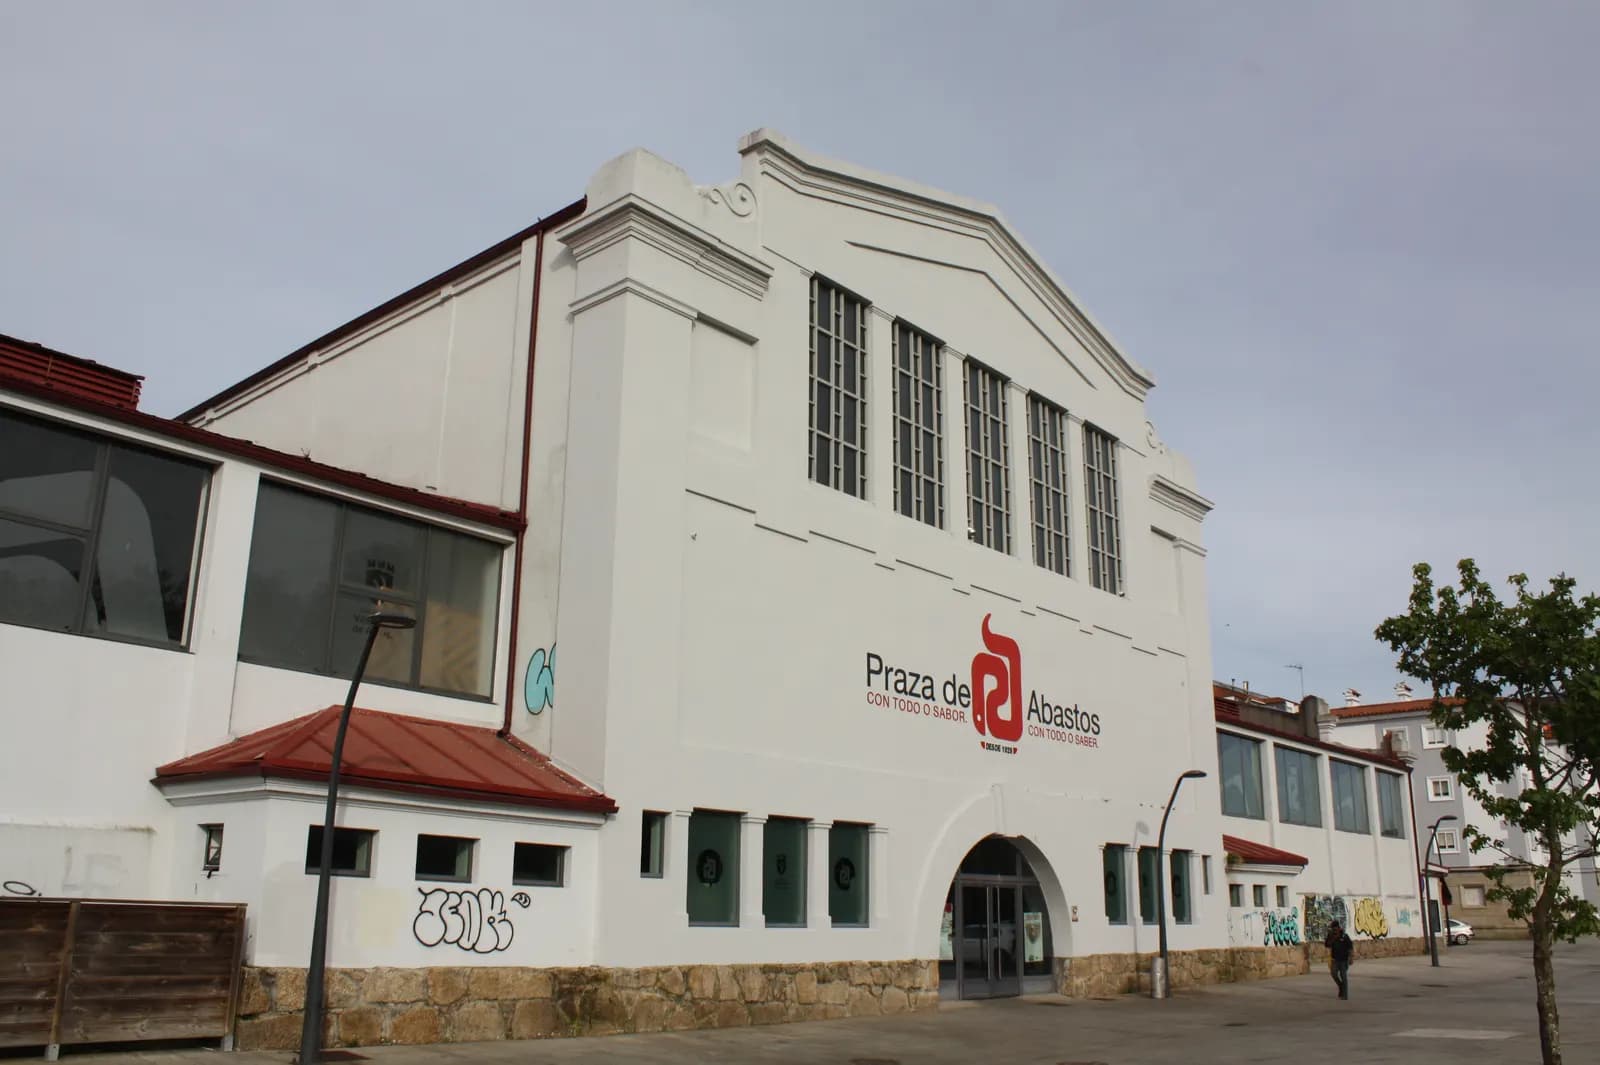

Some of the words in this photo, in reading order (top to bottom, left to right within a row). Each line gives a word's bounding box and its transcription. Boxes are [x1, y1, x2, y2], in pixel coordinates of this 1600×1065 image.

[866, 652, 936, 702] Praza
[942, 672, 971, 708] de
[1027, 689, 1101, 736] Abastos
[866, 691, 890, 708] CON
[892, 696, 921, 714] TODO
[923, 703, 931, 716] O
[933, 705, 968, 723] SABOR.
[985, 742, 1001, 752] DESDE
[1028, 724, 1045, 738] CON
[1046, 728, 1067, 743] TODO
[1067, 733, 1074, 744] O
